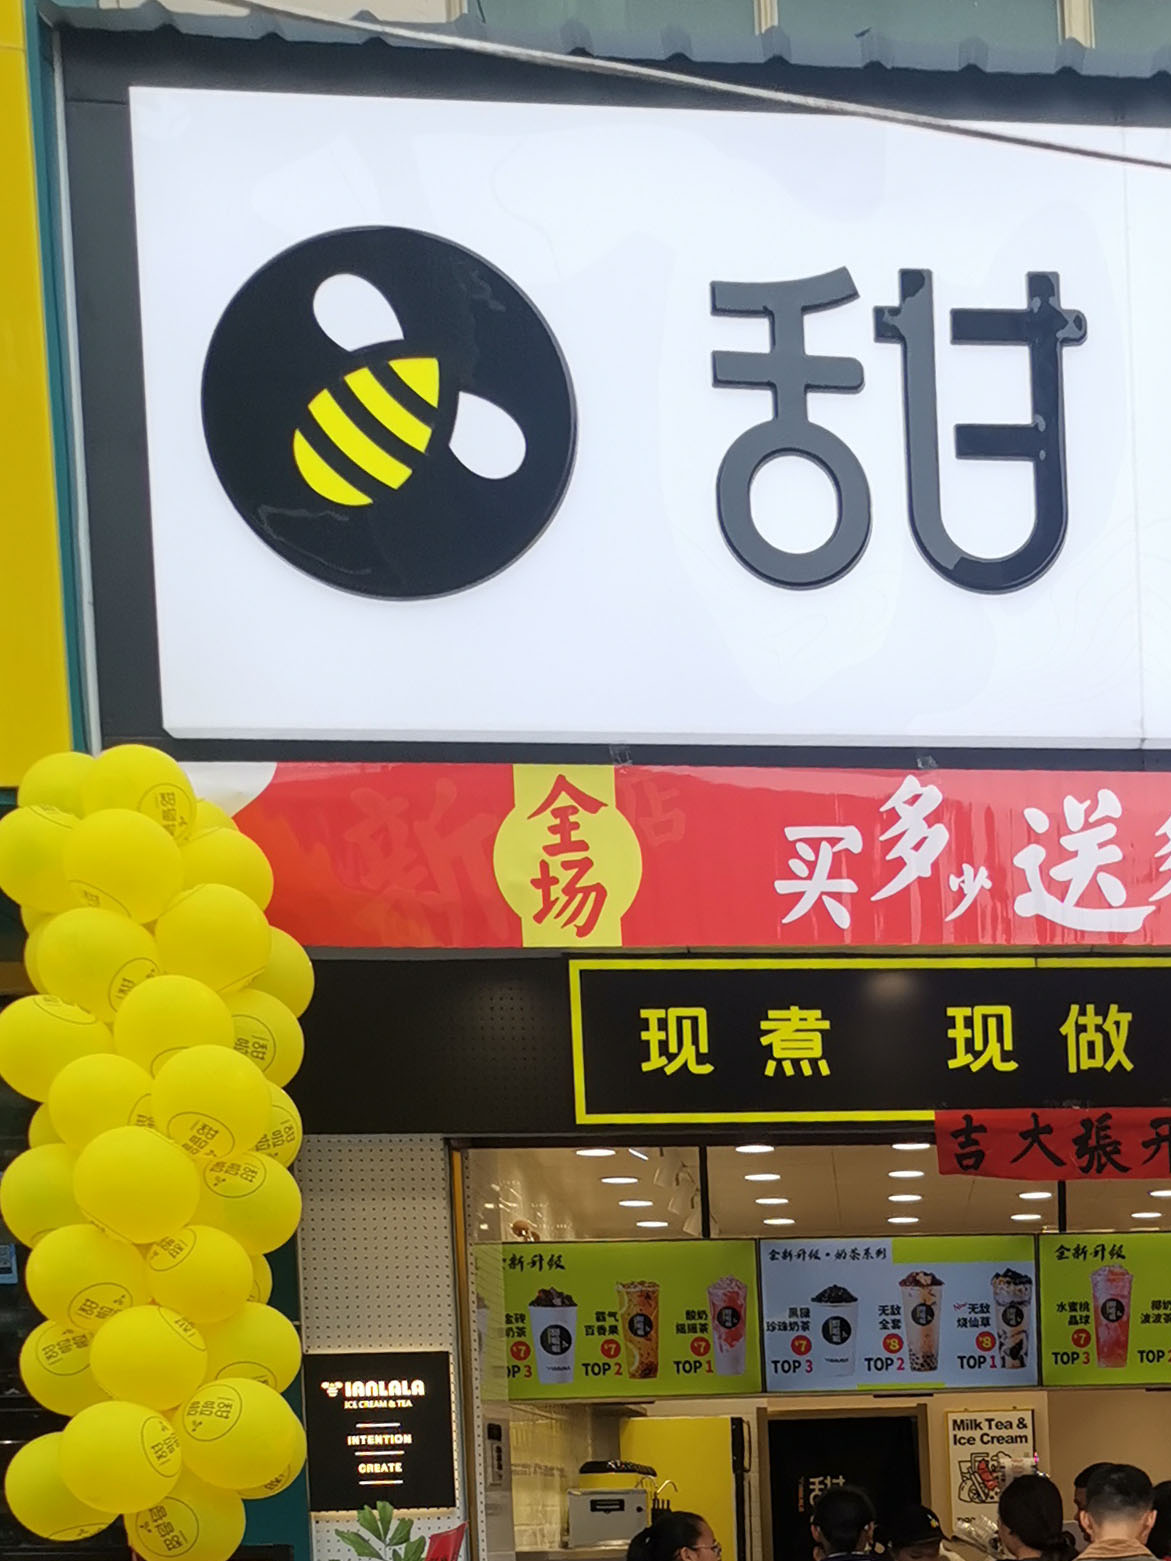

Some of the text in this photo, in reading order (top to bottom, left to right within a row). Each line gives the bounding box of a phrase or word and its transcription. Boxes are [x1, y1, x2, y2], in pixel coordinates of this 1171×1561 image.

[526, 773, 609, 938] 全场
[639, 1005, 831, 1079] 现煮
[946, 1003, 1135, 1075] 现做
[503, 1253, 565, 1272] 新升级
[865, 1357, 893, 1371] TOP
[957, 1355, 987, 1369] TOP
[1052, 1351, 1080, 1365] TOP
[1137, 1350, 1165, 1364] TOP
[582, 1362, 611, 1377] TOP
[673, 1360, 702, 1374] TOP
[771, 1359, 801, 1374] TOP
[397, 1399, 412, 1408] TEA
[952, 1417, 1028, 1431] Milk Tea &
[347, 1434, 412, 1445] INTENTION
[953, 1432, 1028, 1445] Ice Cream
[357, 1462, 402, 1474] CREATE
